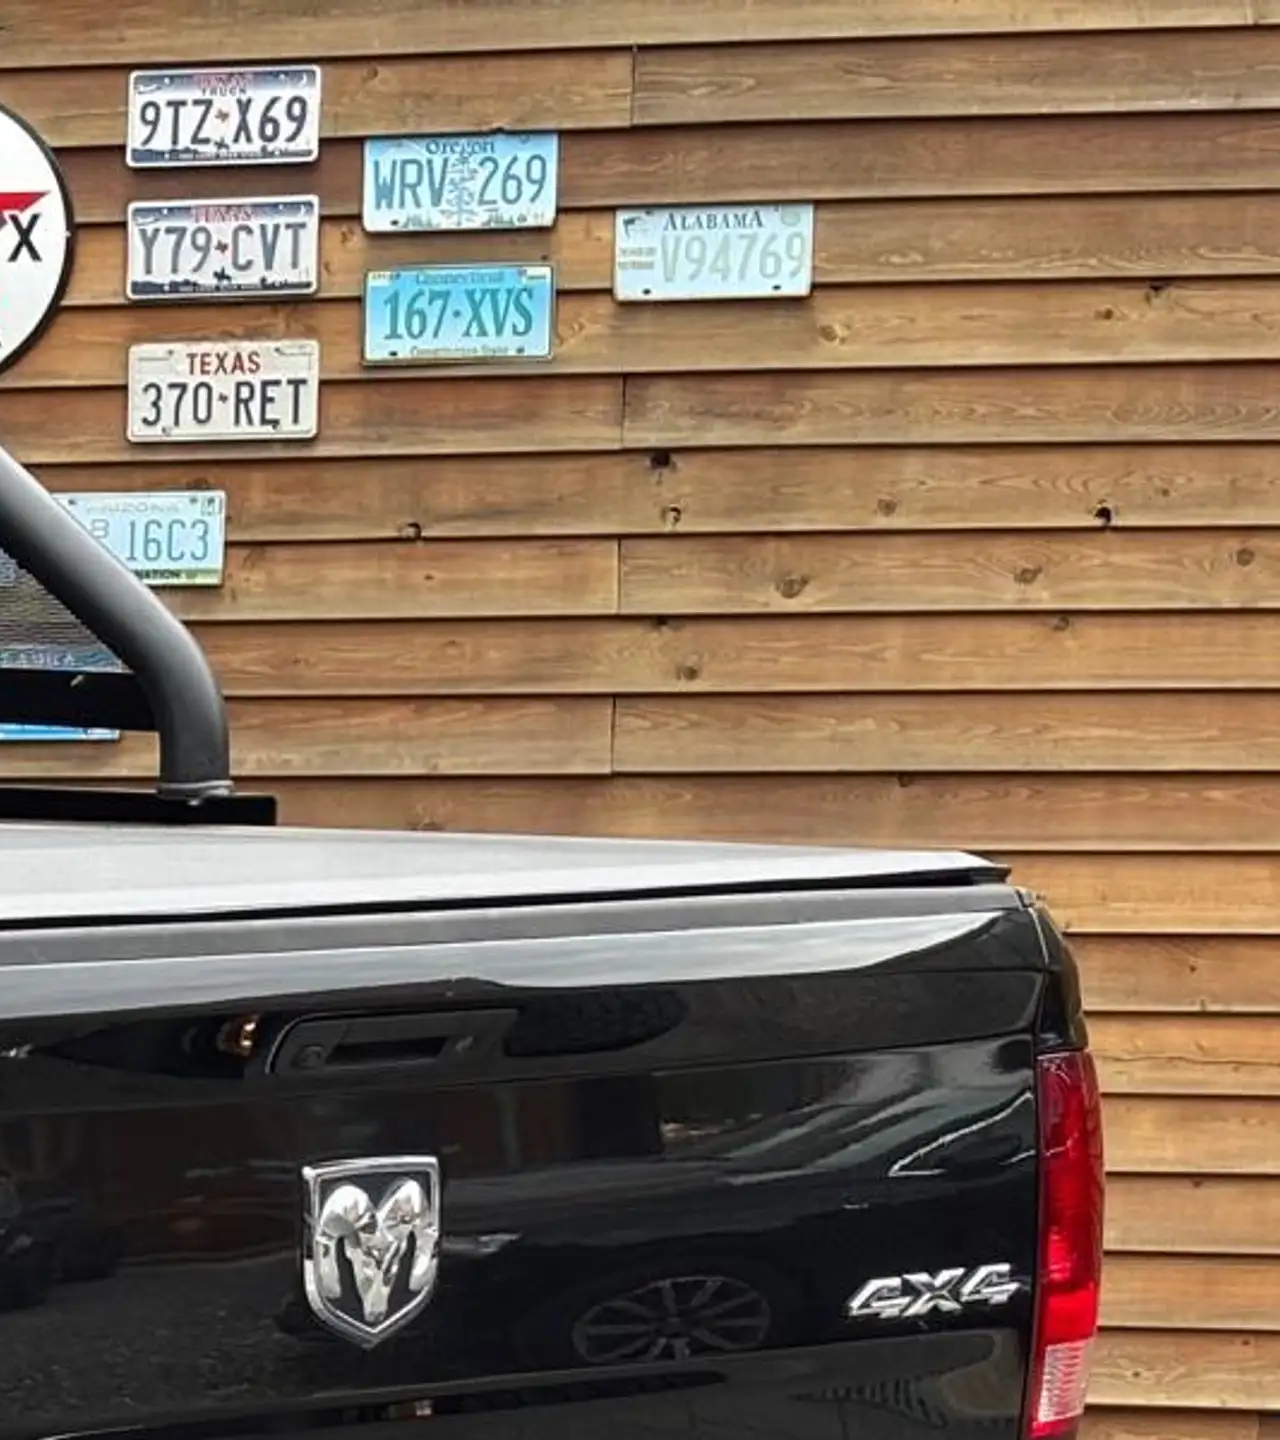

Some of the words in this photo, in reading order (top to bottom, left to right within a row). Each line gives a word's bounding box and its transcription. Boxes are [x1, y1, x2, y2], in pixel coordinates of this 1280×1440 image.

[424, 138, 497, 158] Oregon
[662, 209, 765, 232] ALABAMA
[660, 231, 807, 284] V94769
[185, 350, 263, 377] TEXAS
